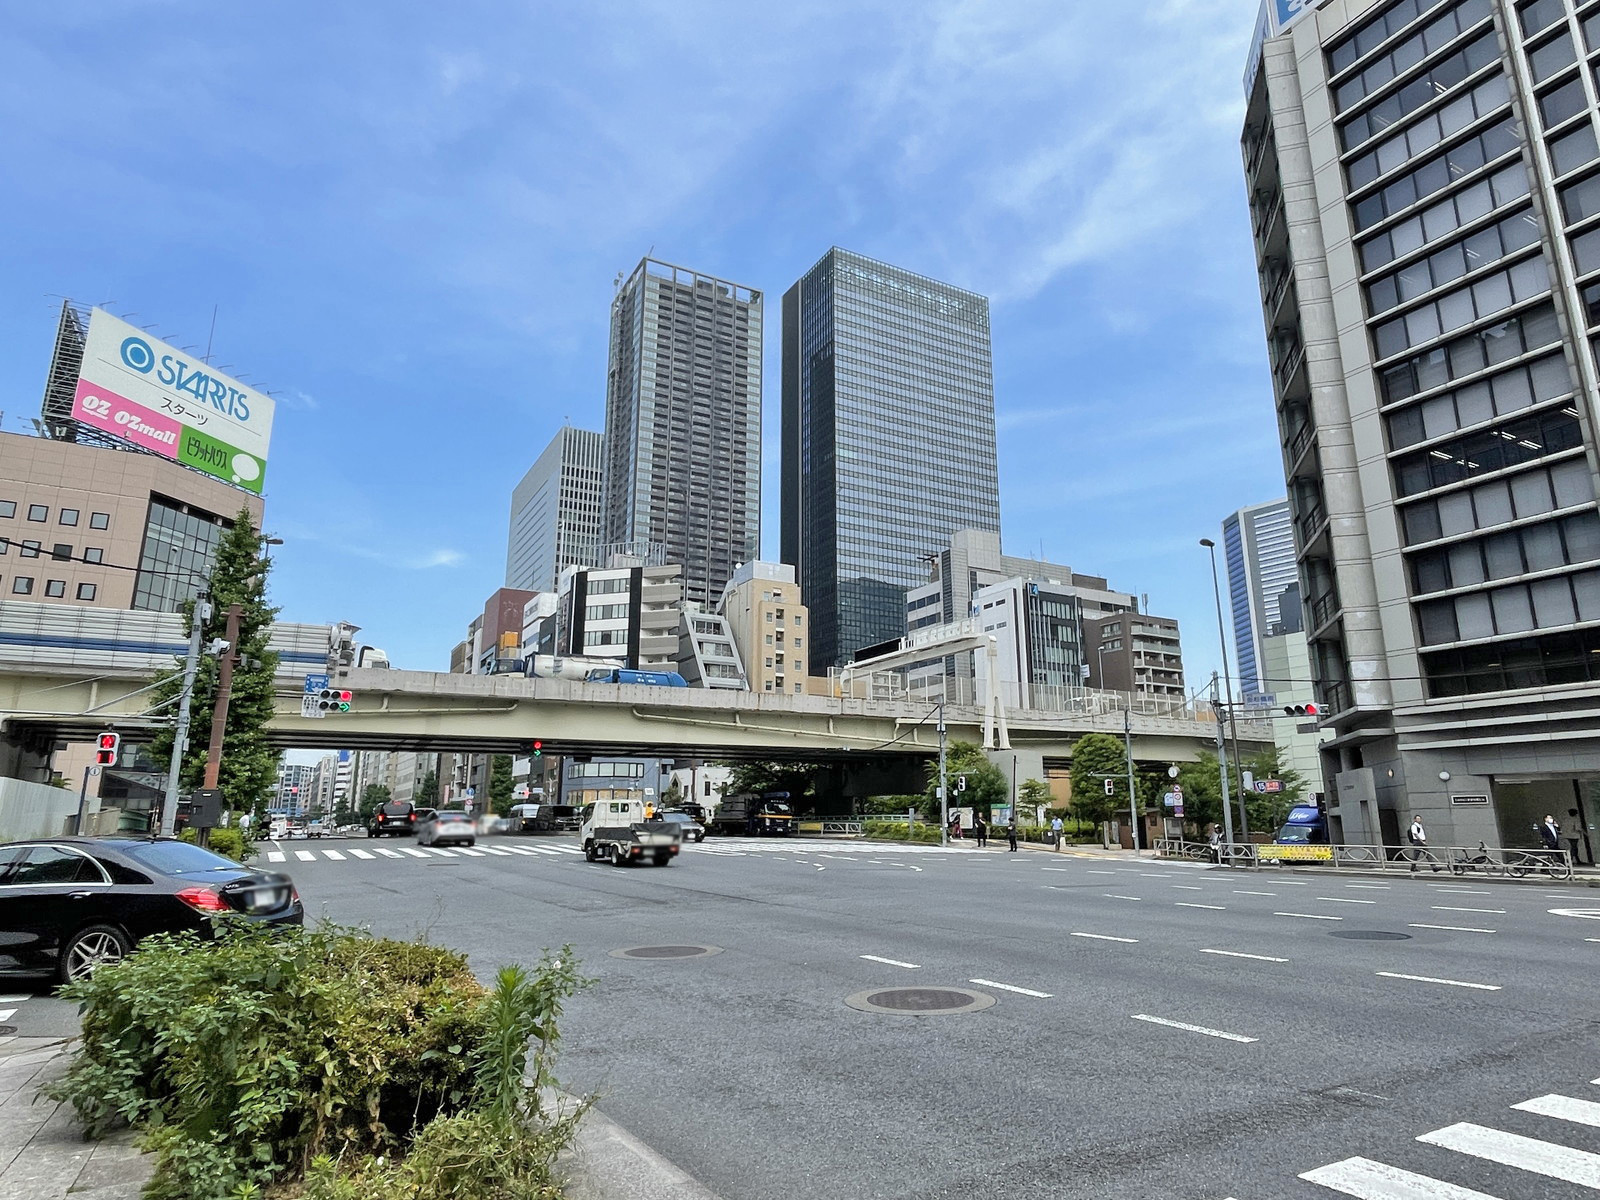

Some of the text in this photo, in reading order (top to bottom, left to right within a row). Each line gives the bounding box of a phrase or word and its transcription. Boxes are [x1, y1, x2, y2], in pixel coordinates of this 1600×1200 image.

[157, 355, 249, 421] STARTS
[82, 395, 112, 415] OZ
[160, 397, 209, 426] スターツ
[114, 411, 177, 445] OZmall
[186, 436, 227, 470] ピタットハウス
[1258, 782, 1265, 790] 15
